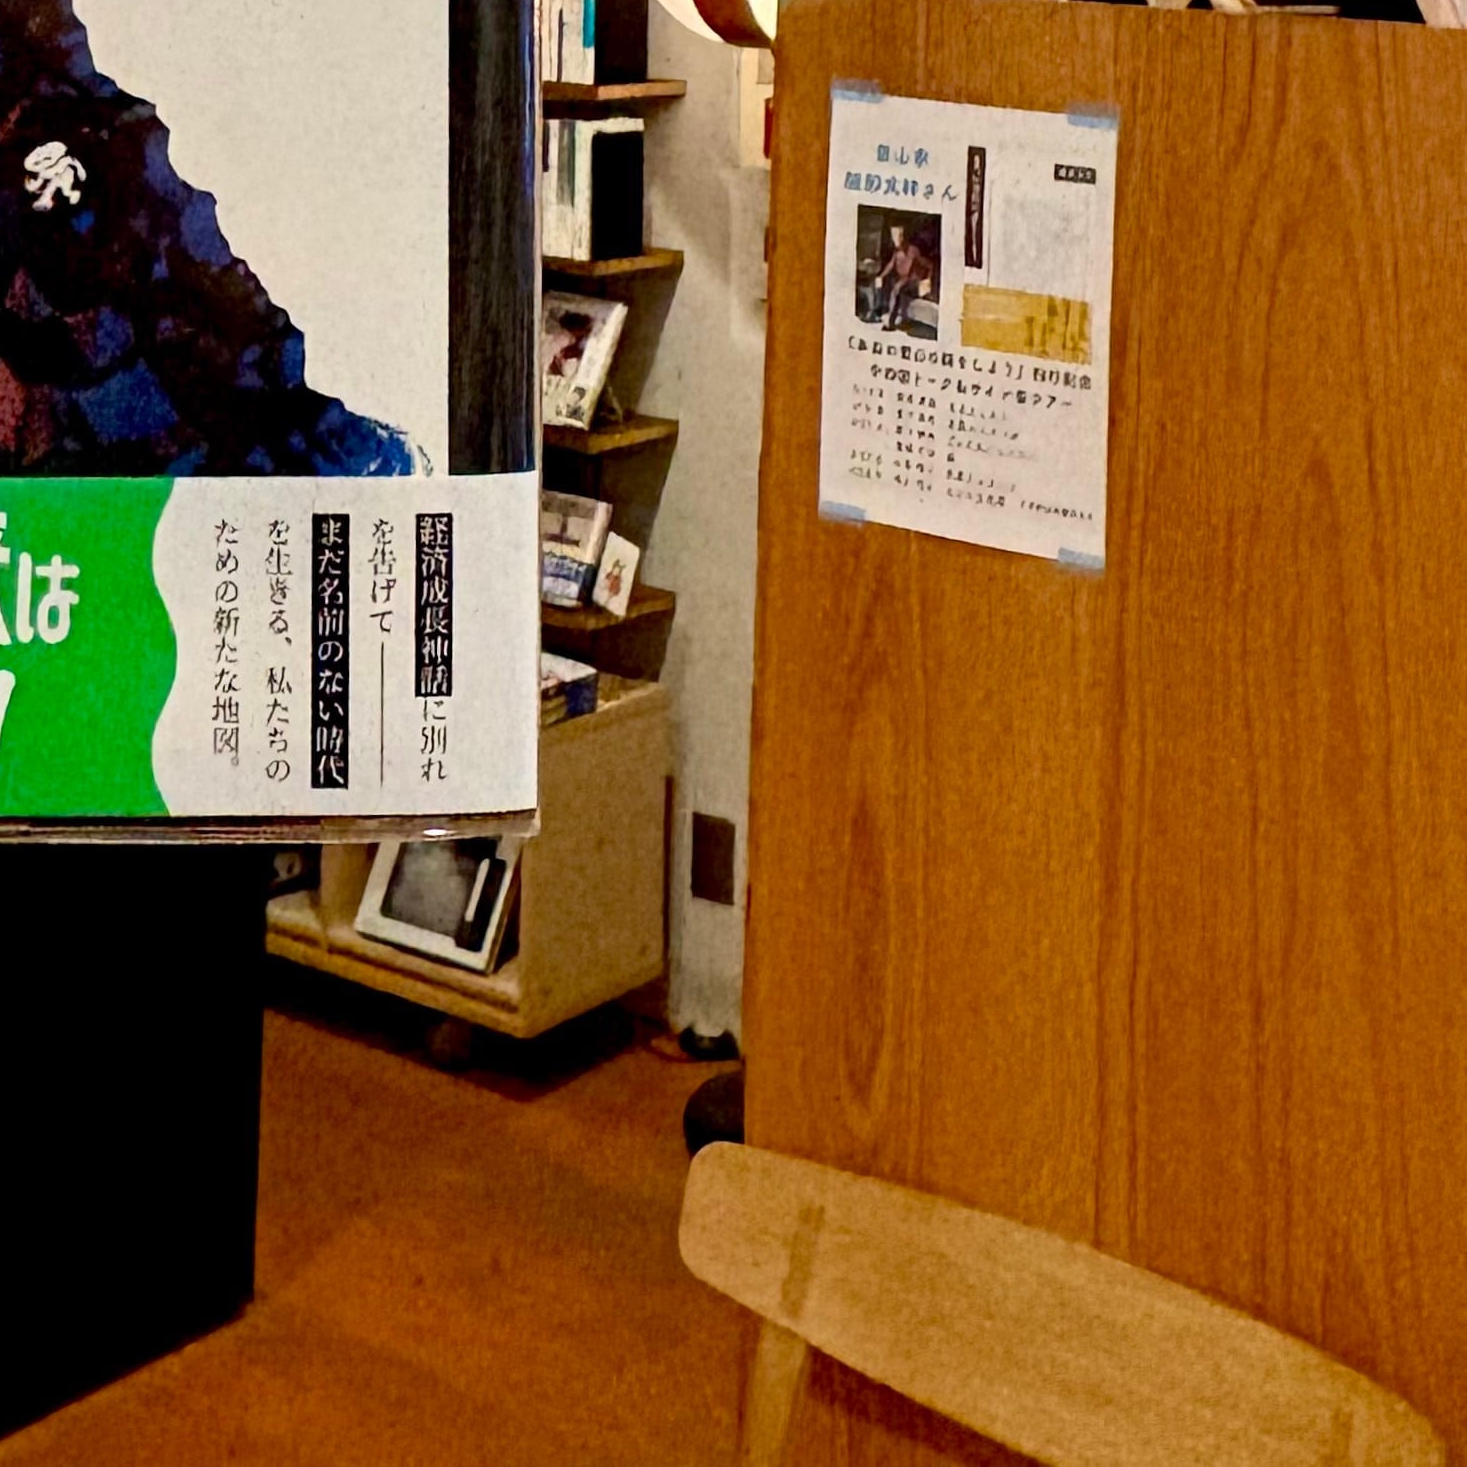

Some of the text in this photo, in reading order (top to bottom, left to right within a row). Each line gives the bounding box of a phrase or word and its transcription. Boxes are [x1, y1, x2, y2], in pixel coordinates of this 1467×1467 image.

[212, 518, 240, 768] ための新たな地図。
[315, 518, 345, 786] まだ名前のない時代
[418, 516, 449, 782] 経済成長神話に別れ
